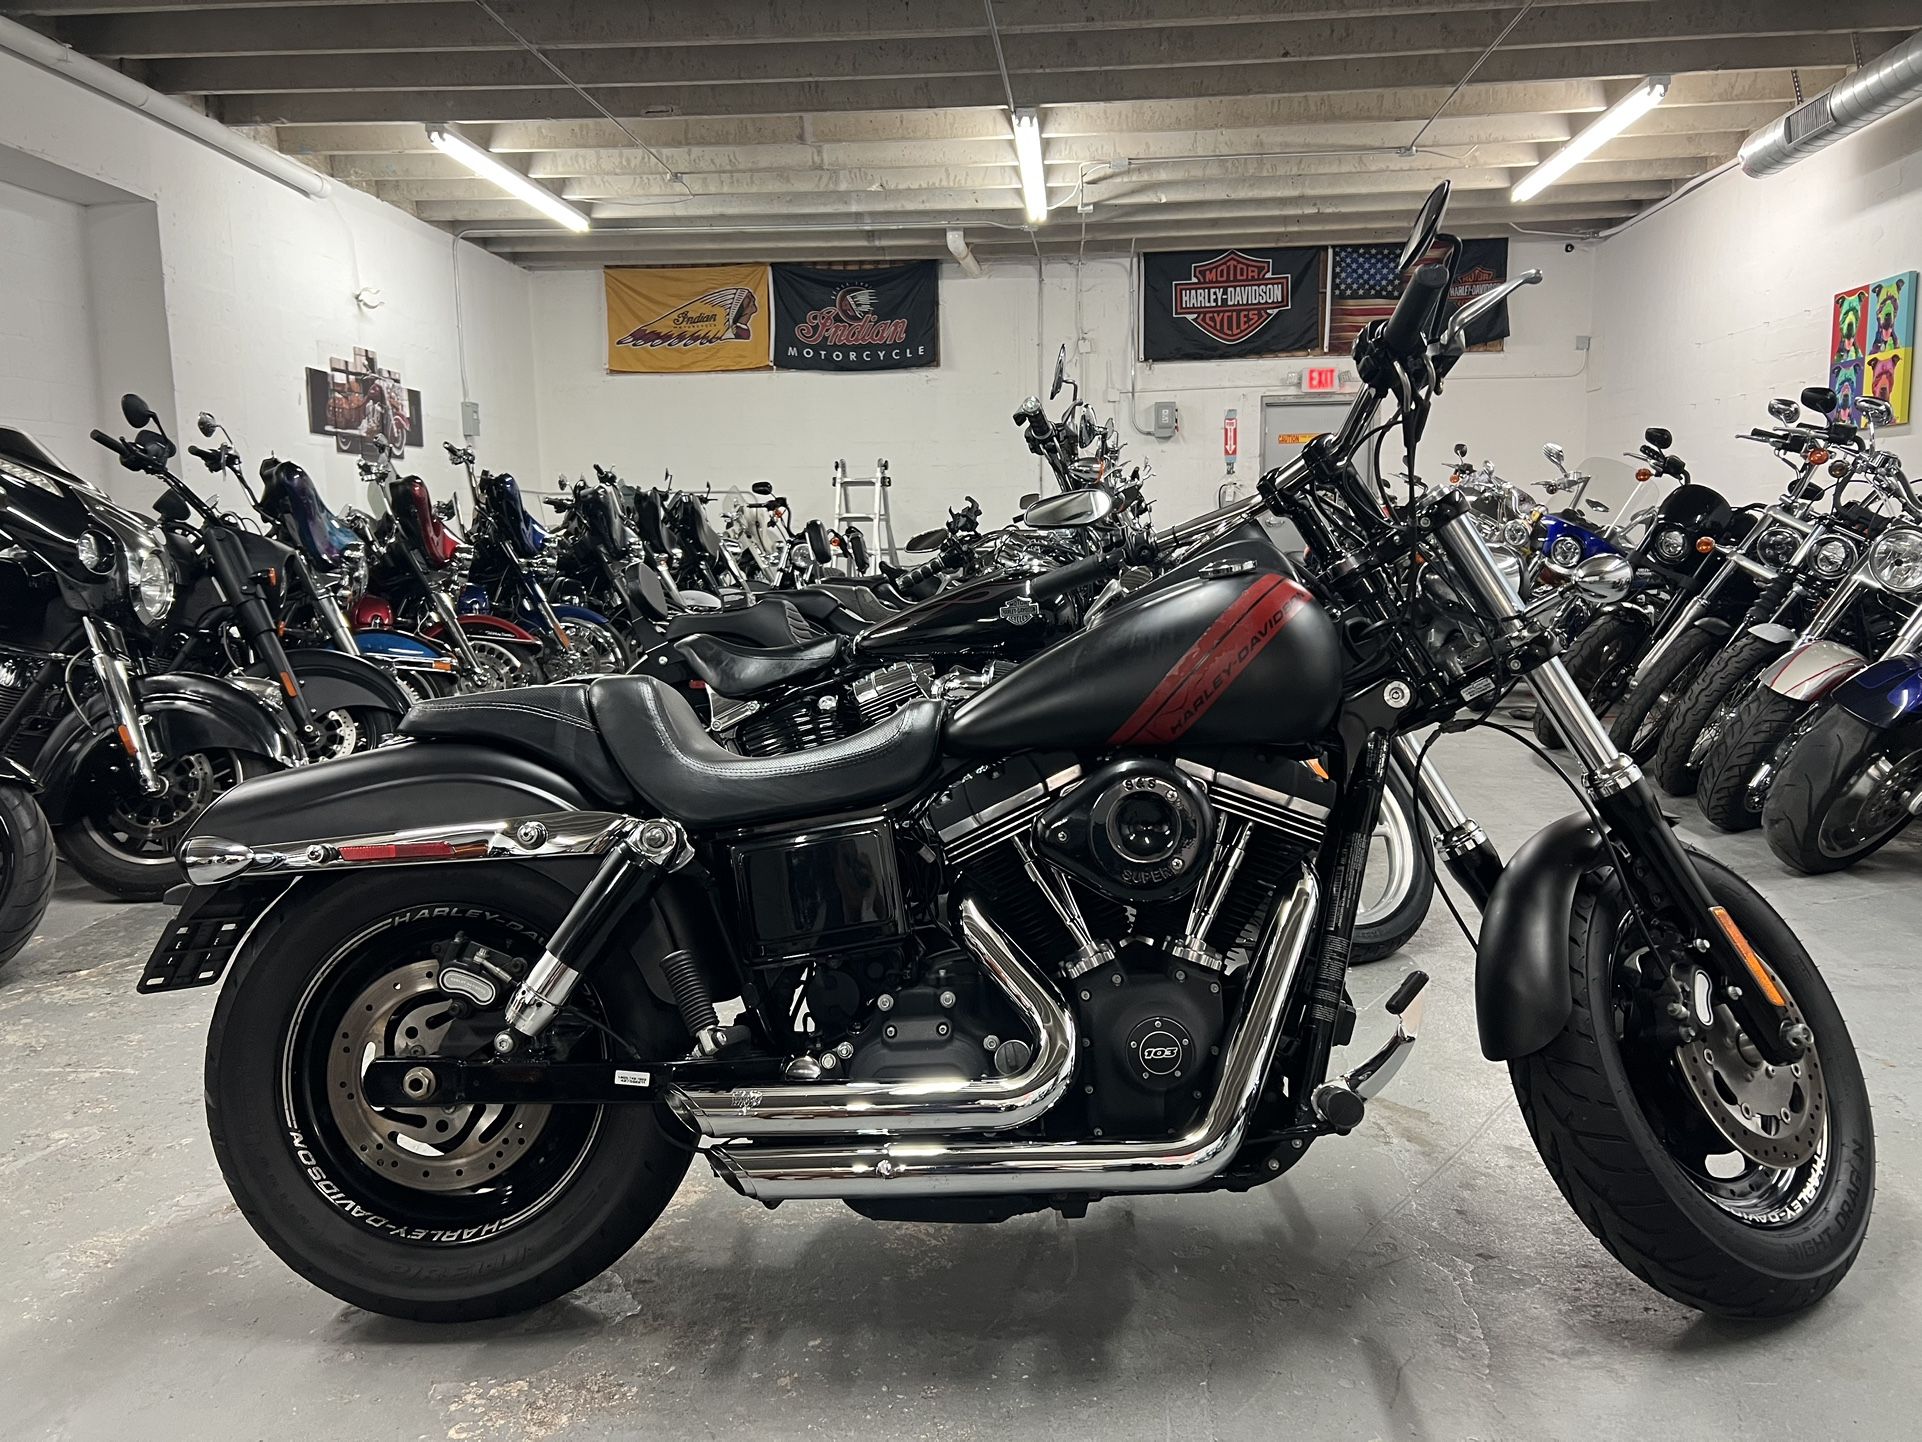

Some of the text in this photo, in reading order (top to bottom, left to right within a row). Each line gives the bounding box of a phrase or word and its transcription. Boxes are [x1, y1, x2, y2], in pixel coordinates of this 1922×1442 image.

[1206, 260, 1258, 281] MOTOR
[1182, 284, 1282, 307] HARLEY-DAVIDSON
[673, 311, 717, 325] Indian
[795, 306, 907, 345] Indian
[1205, 310, 1258, 334] CYCLES
[787, 346, 925, 361] MOTORCYCLE
[1309, 368, 1334, 389] EXIT
[1121, 867, 1174, 884] SUPER
[1144, 1047, 1178, 1059] 103
[289, 1129, 502, 1242] HARLEY-DAVIDSON
[1784, 1226, 1833, 1260] NIGHT
